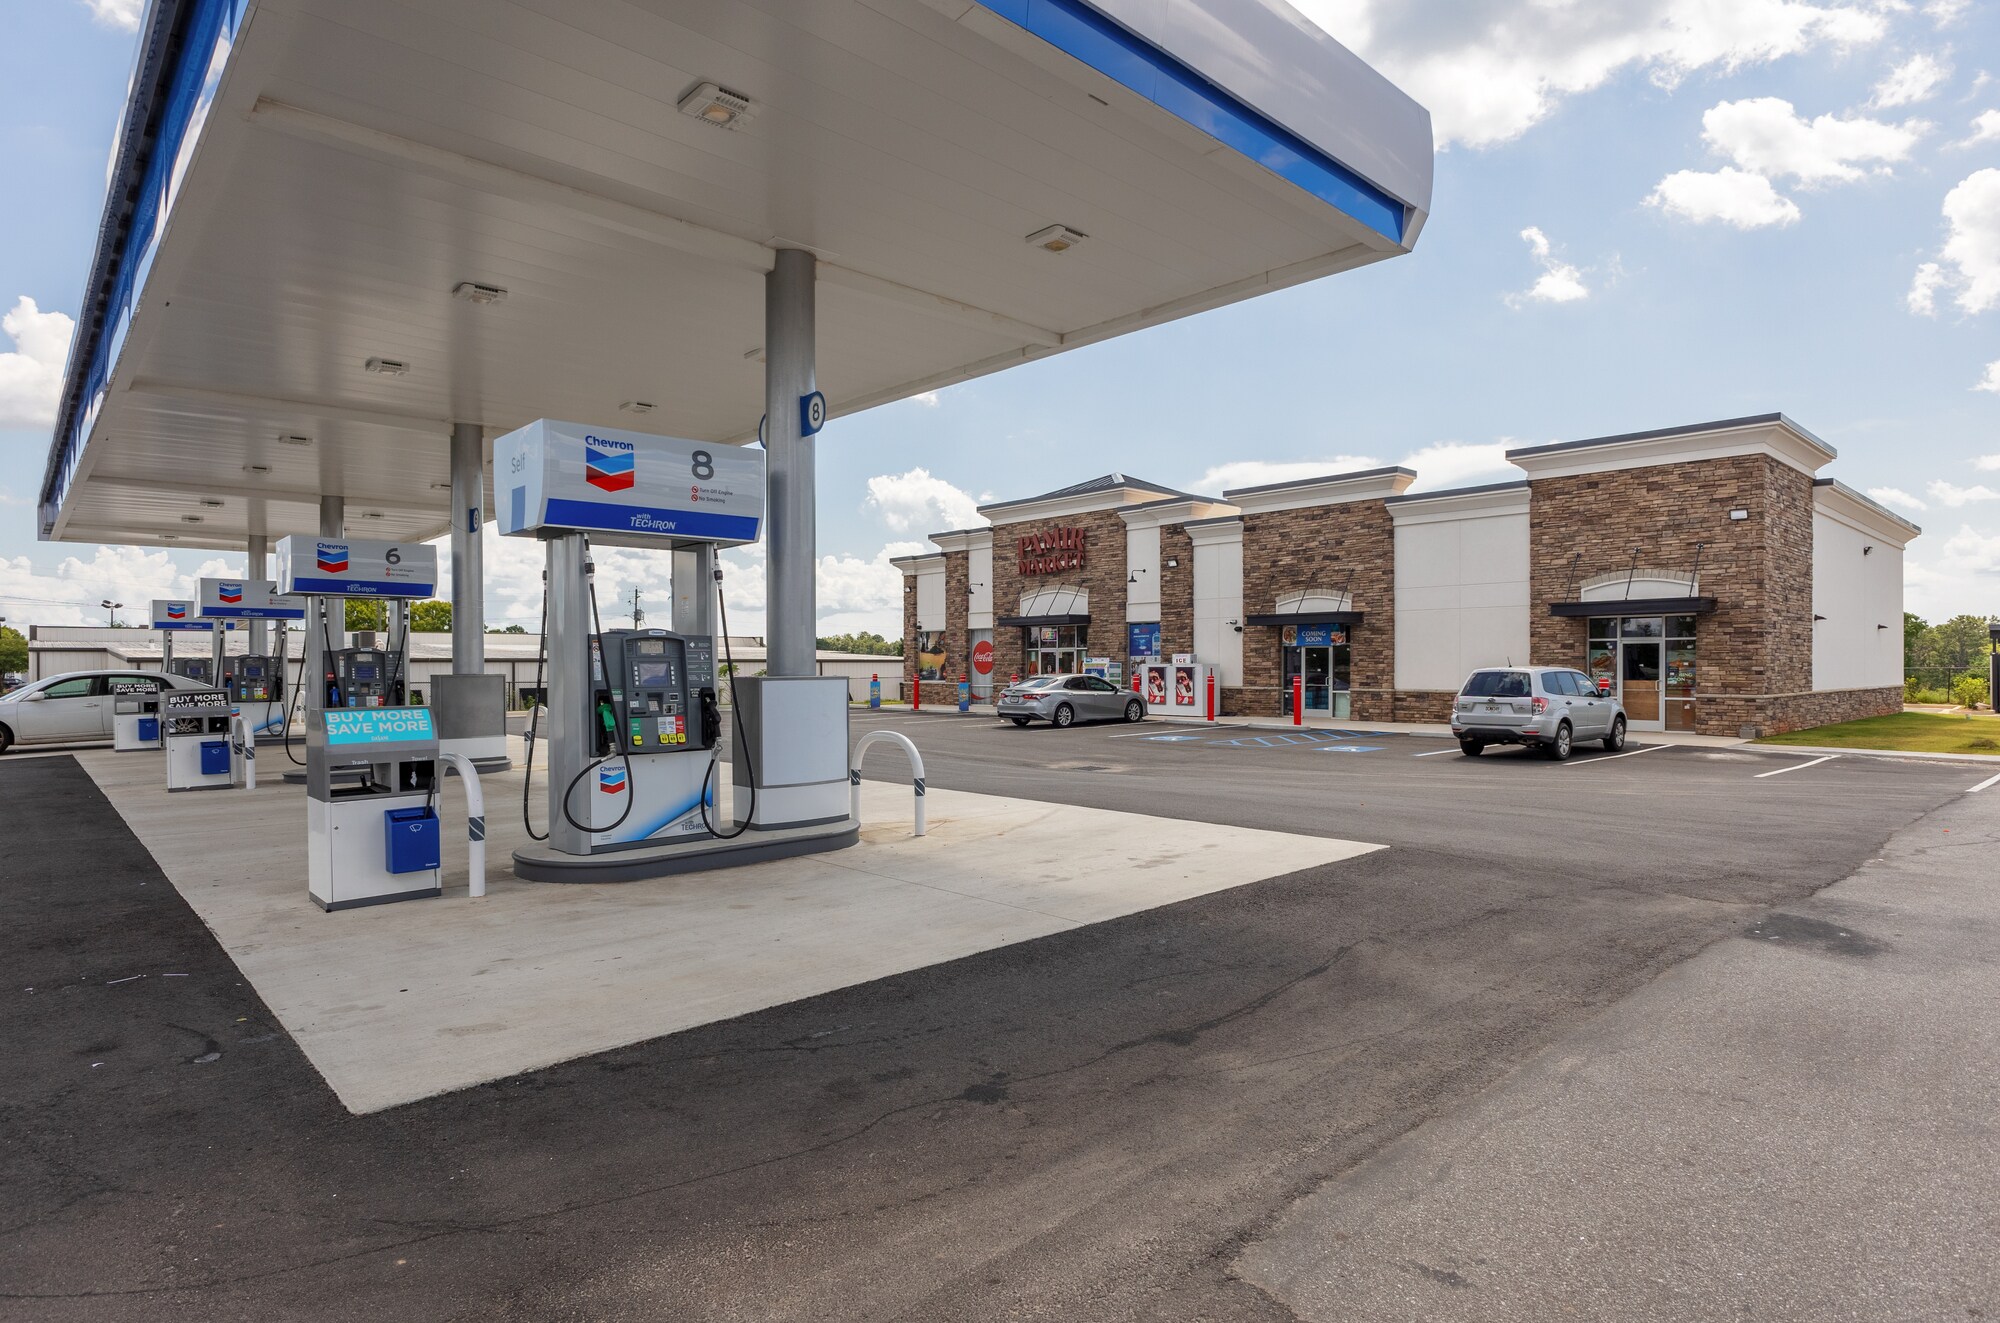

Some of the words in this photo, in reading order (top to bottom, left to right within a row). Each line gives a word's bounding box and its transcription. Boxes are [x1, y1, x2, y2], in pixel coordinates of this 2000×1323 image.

[812, 402, 820, 422] 8
[585, 435, 634, 451] Chevron
[511, 453, 525, 474] Self
[691, 450, 714, 481] 8
[630, 516, 676, 531] TECHRON
[317, 542, 349, 551] Chevron
[1018, 528, 1083, 559] PAMIR
[385, 547, 401, 565] 6
[1018, 552, 1083, 576] MARKET
[347, 585, 377, 593] TECHRON
[169, 695, 191, 704] BUY
[194, 693, 225, 702] MORE
[196, 700, 227, 708] MORE
[328, 712, 365, 723] BUY
[371, 709, 424, 721] MORE
[327, 722, 374, 735] SAVE
[379, 720, 429, 732] MORE
